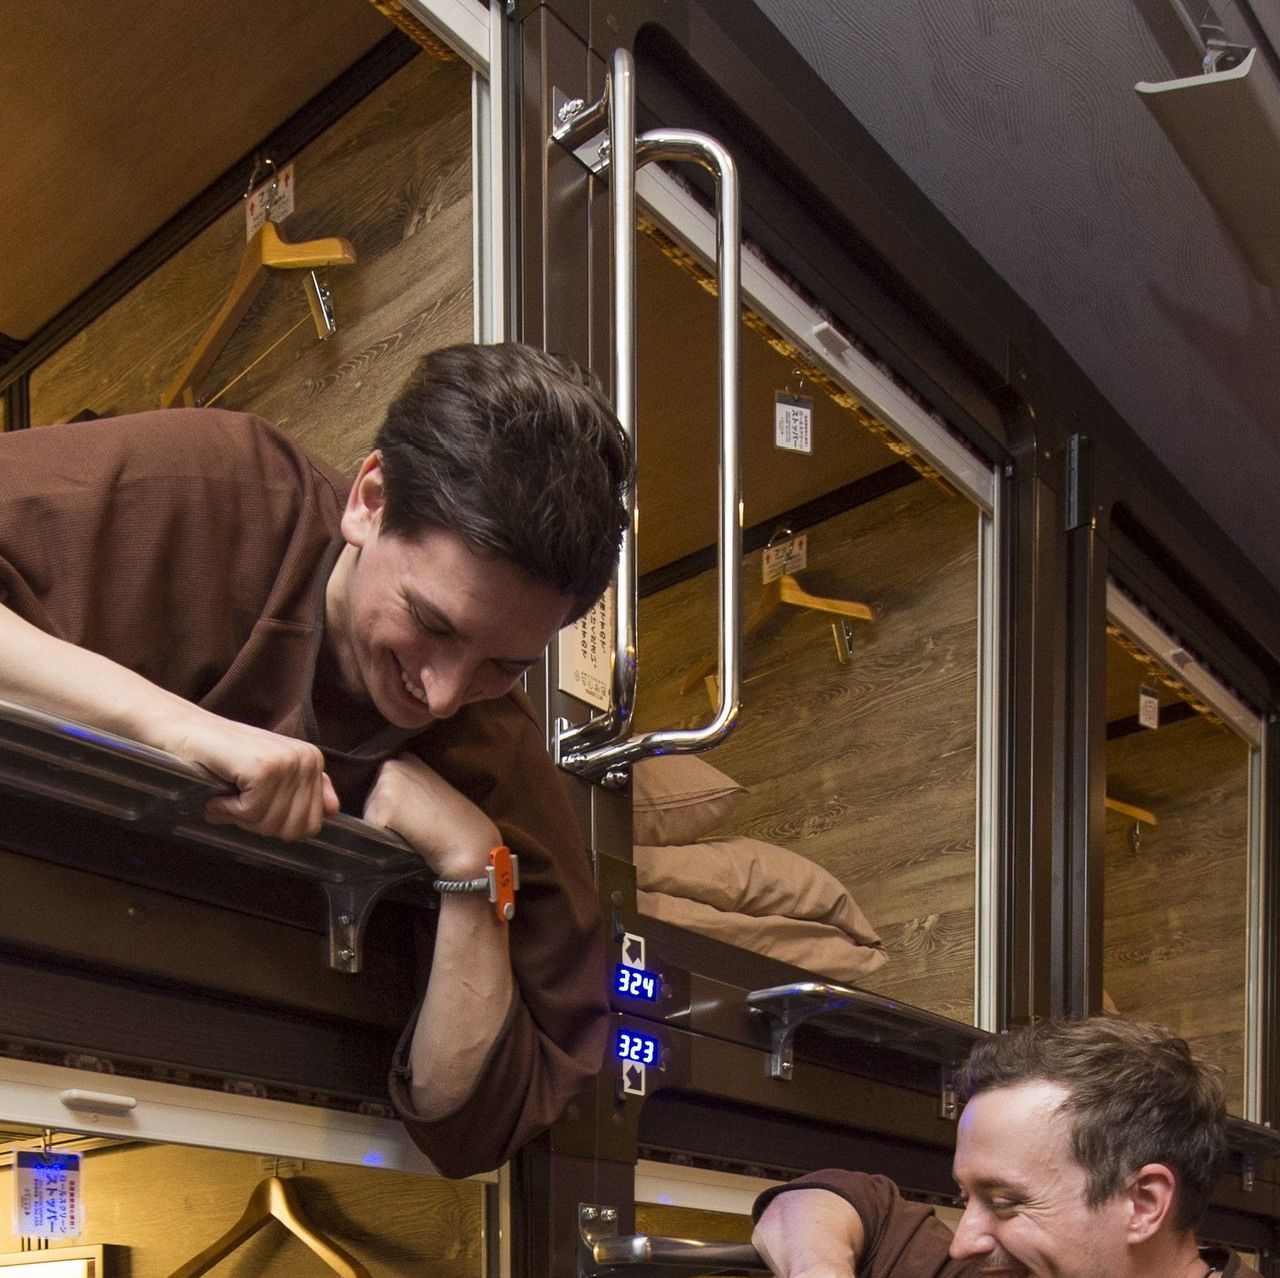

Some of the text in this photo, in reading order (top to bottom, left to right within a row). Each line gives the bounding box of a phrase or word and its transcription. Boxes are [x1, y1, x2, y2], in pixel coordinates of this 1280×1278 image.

[791, 409, 799, 448] ストッパー
[618, 969, 654, 998] 324
[618, 1034, 655, 1063] 323
[46, 1174, 58, 1233] ストッパー
